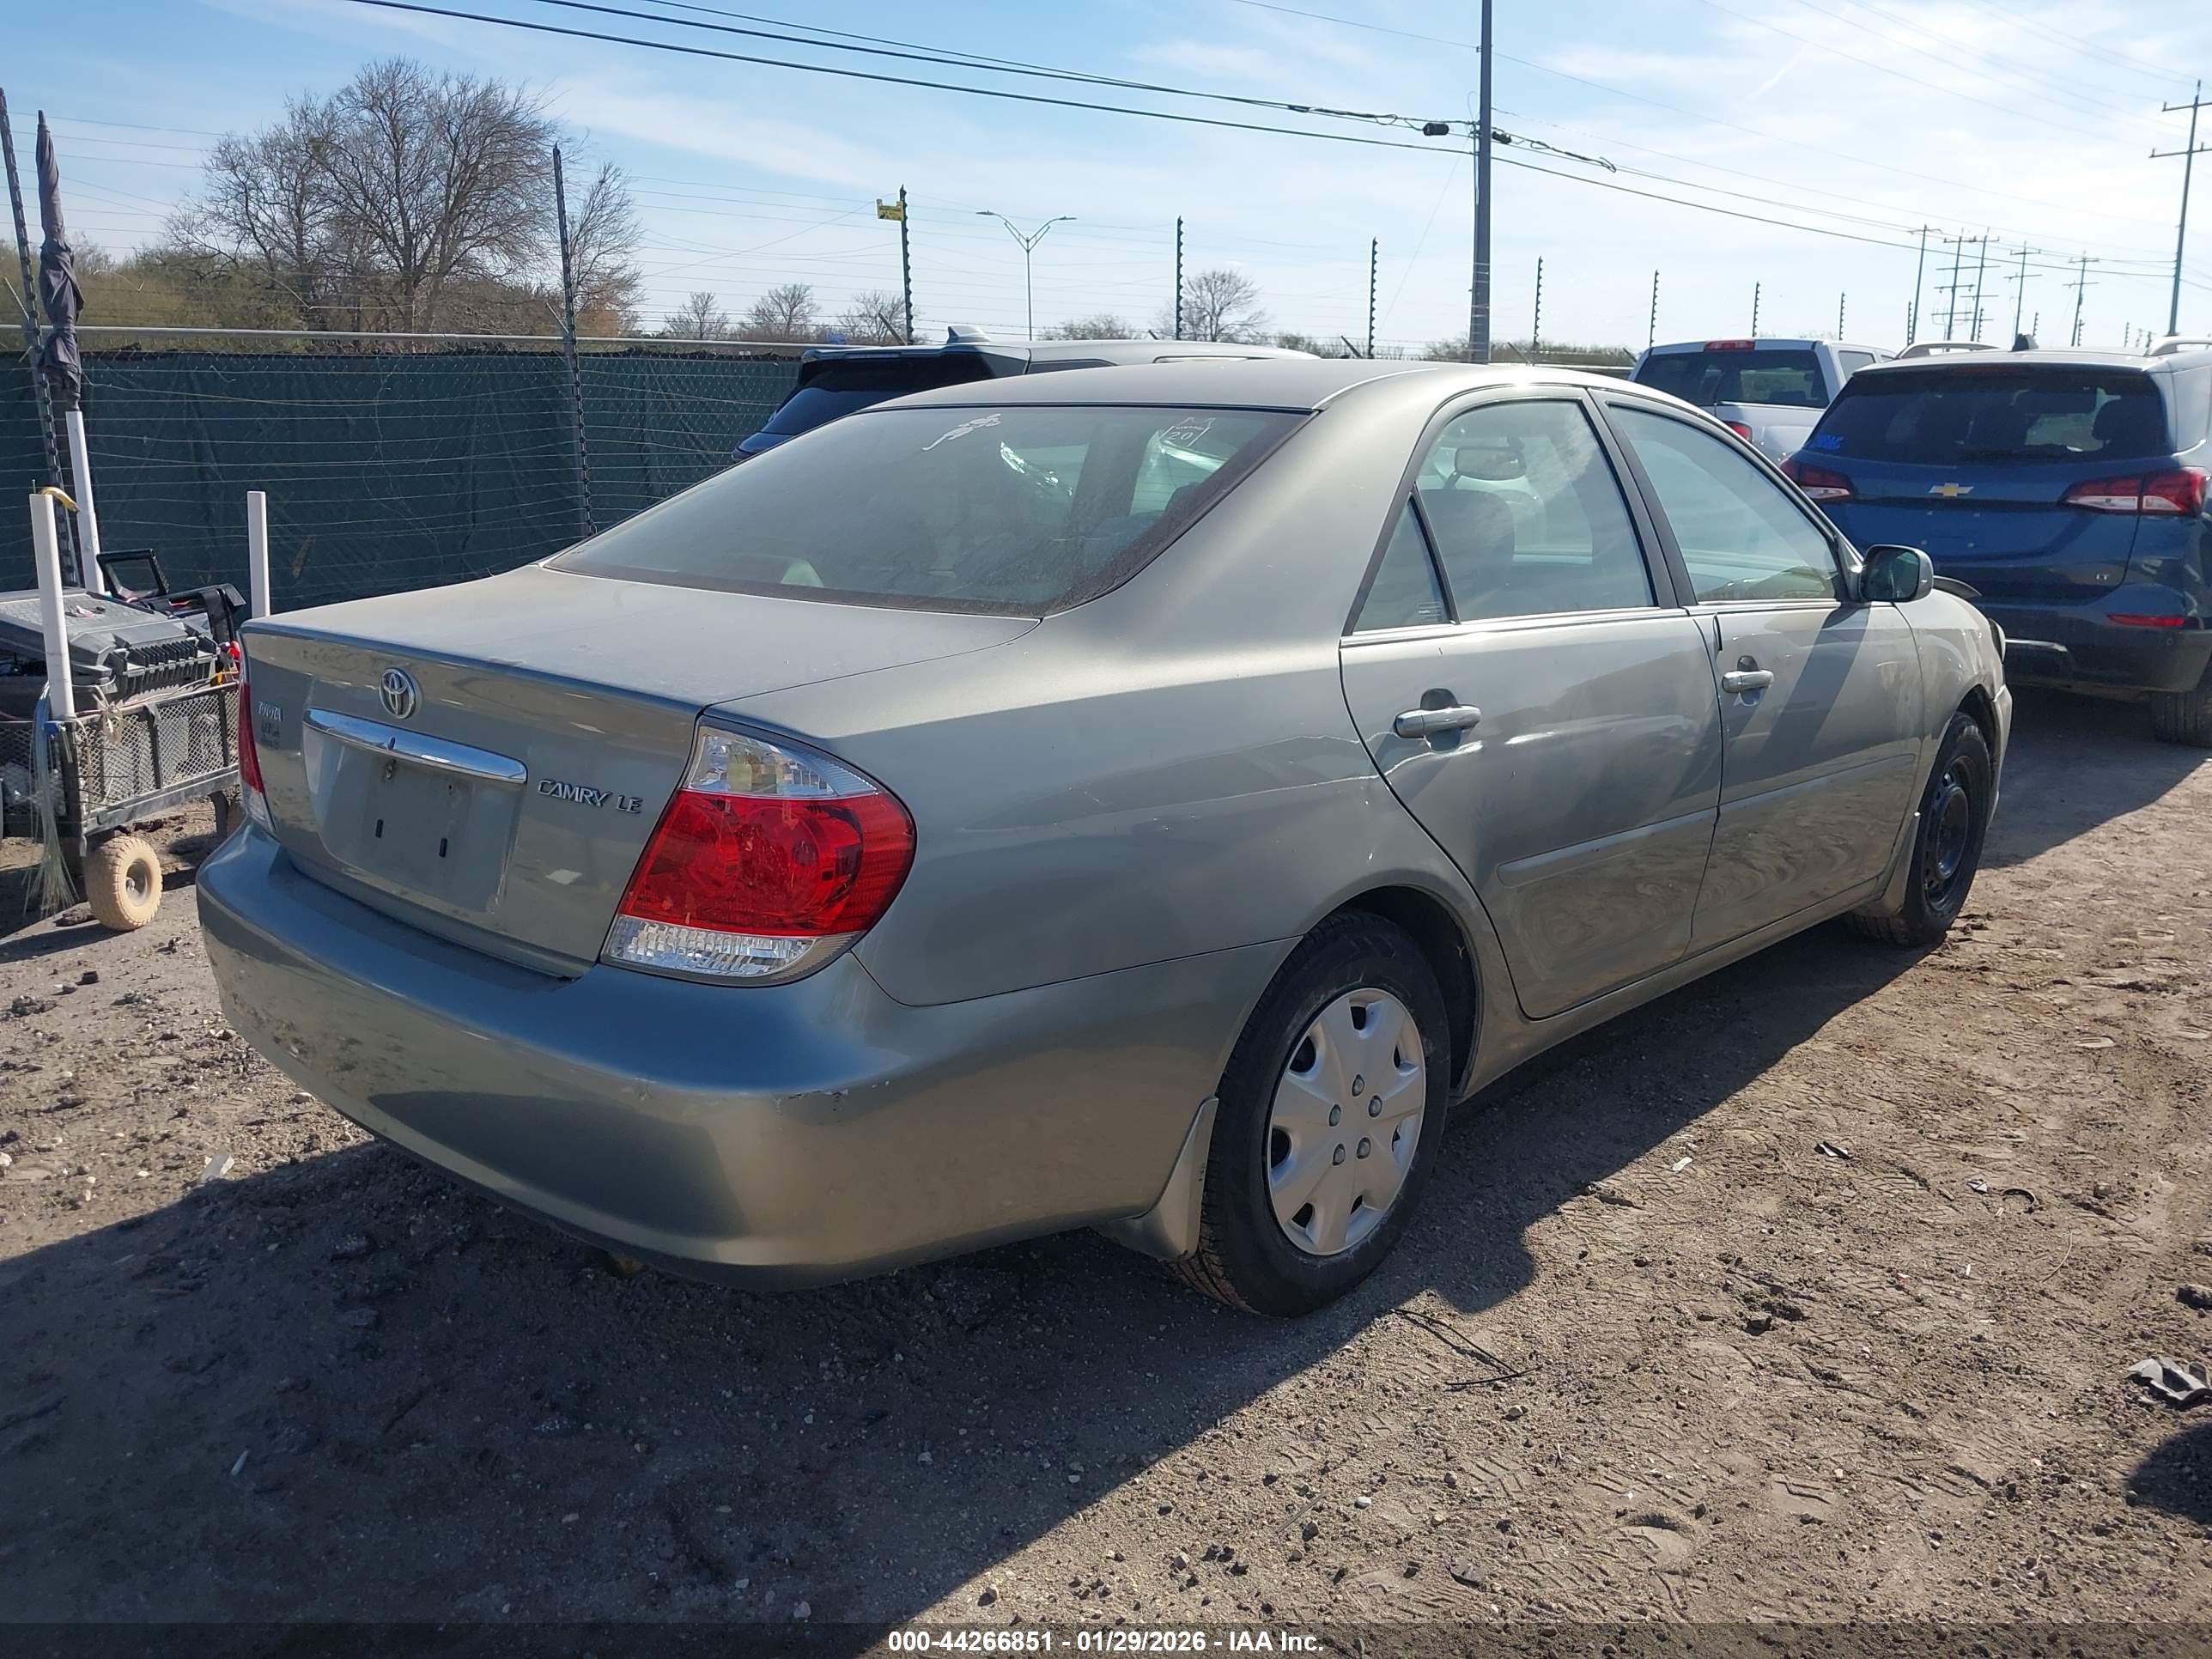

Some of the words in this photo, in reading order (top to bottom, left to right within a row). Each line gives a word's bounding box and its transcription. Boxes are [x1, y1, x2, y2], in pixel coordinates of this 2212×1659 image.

[1167, 431, 1194, 441] 20
[538, 778, 611, 806] CAMRY
[615, 795, 641, 813] LE
